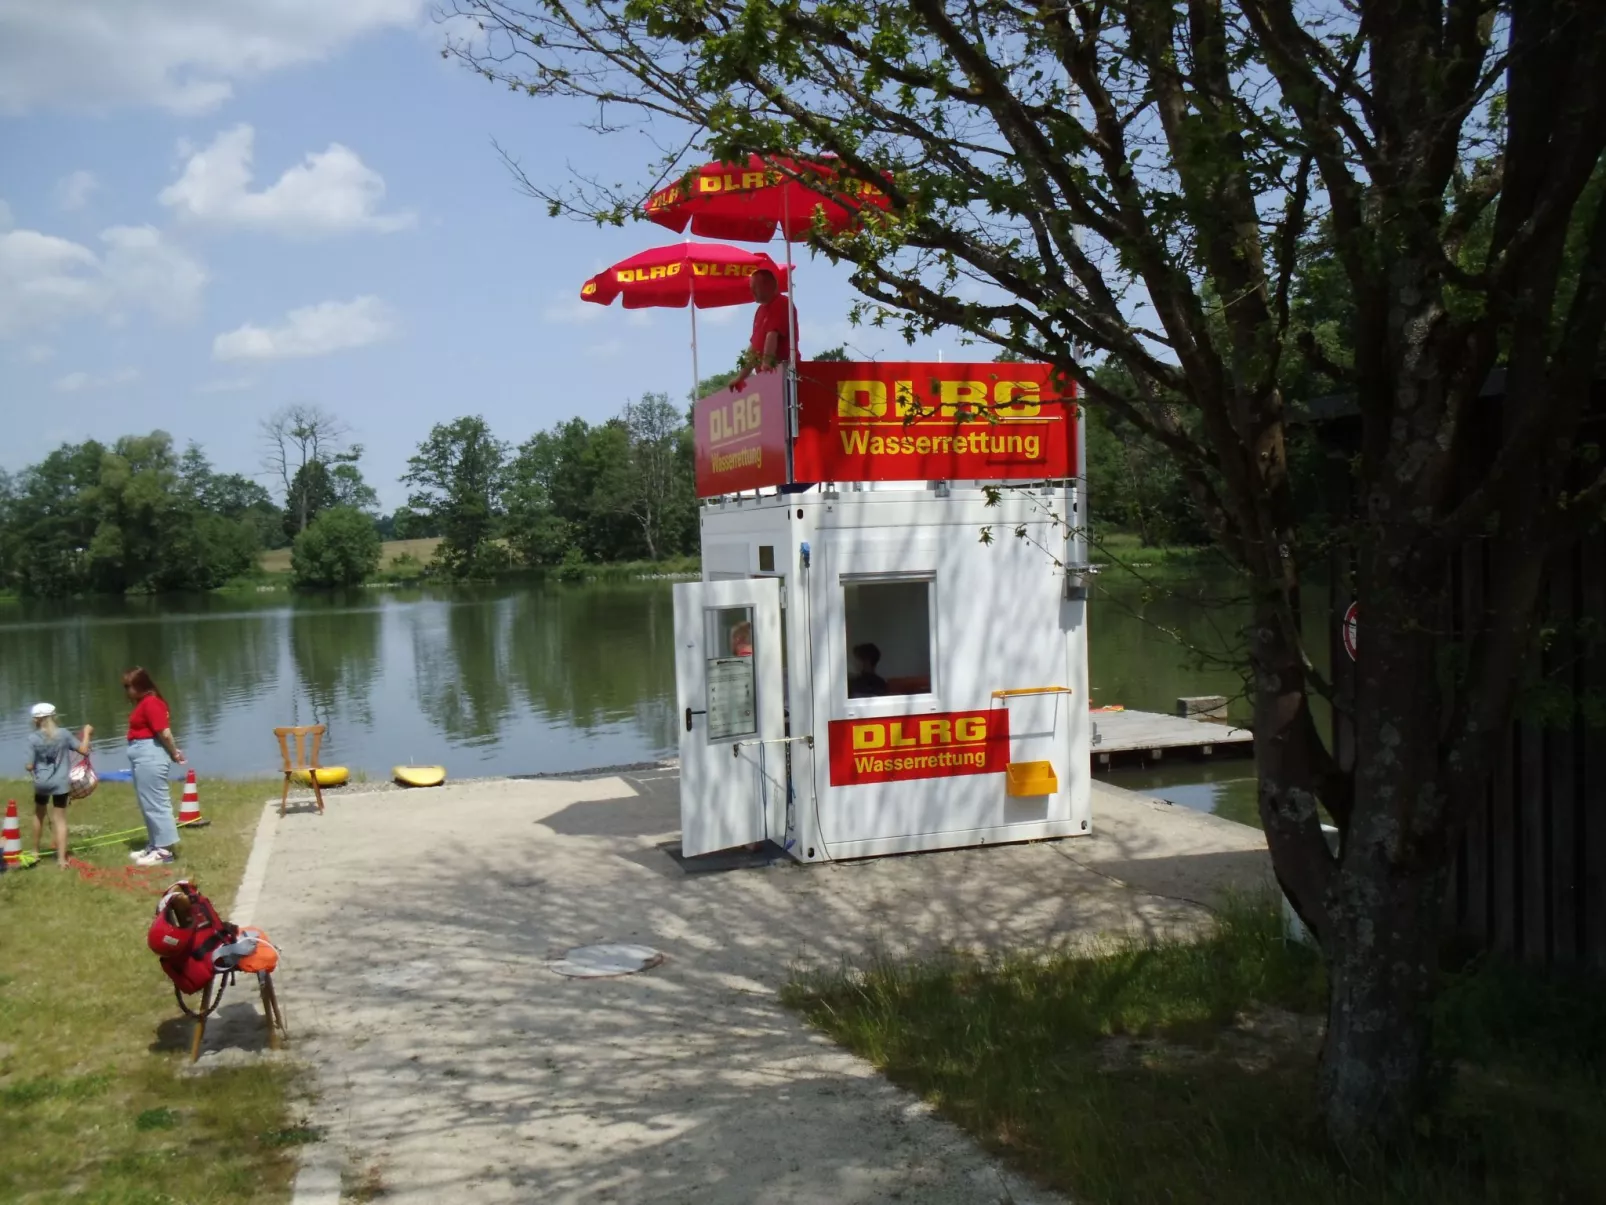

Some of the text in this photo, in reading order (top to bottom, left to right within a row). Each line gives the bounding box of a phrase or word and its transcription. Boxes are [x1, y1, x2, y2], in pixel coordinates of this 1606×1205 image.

[617, 262, 682, 282] DLRG
[692, 262, 758, 277] DLRG
[837, 380, 1041, 417] DLRG
[710, 393, 761, 442] DLRG
[840, 431, 1040, 459] Wasserrettung
[711, 446, 762, 474] Wasserrettung
[852, 716, 987, 750] DLRG
[854, 751, 986, 774] Wasserrettung
